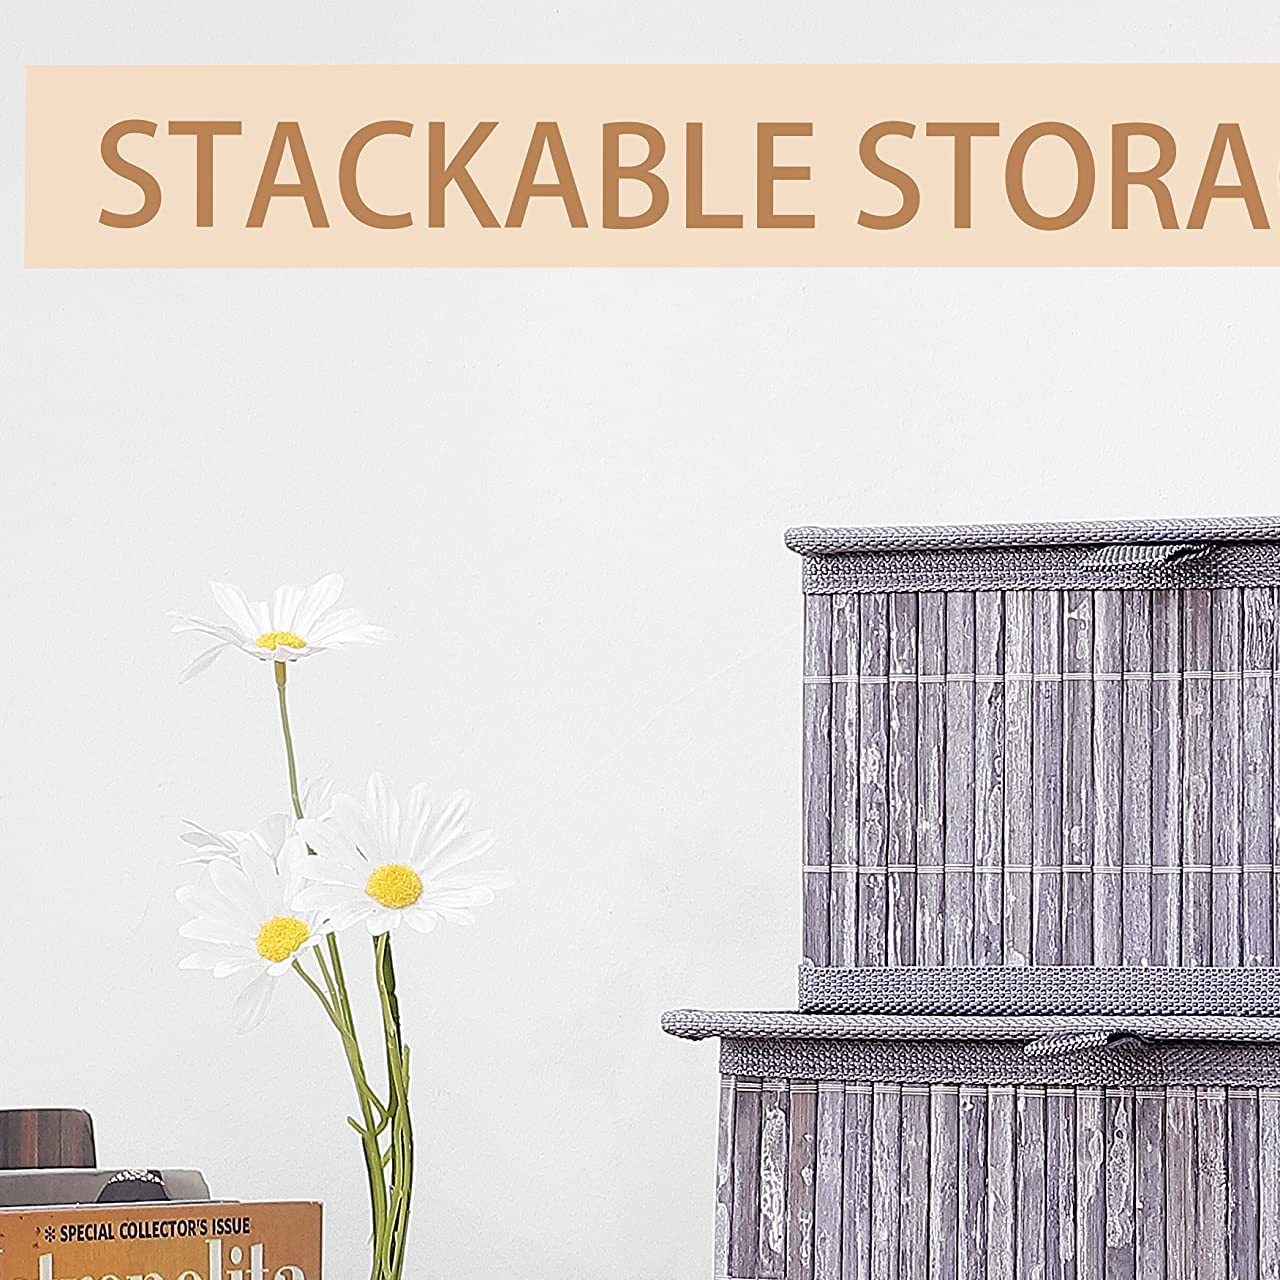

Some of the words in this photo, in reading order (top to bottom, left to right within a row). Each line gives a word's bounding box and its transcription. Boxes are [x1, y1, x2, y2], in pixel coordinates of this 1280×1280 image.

[60, 1223, 115, 1243] SPECIAL
[119, 1219, 208, 1239] COLLECTOR'S
[212, 1217, 250, 1235] ISSUE
